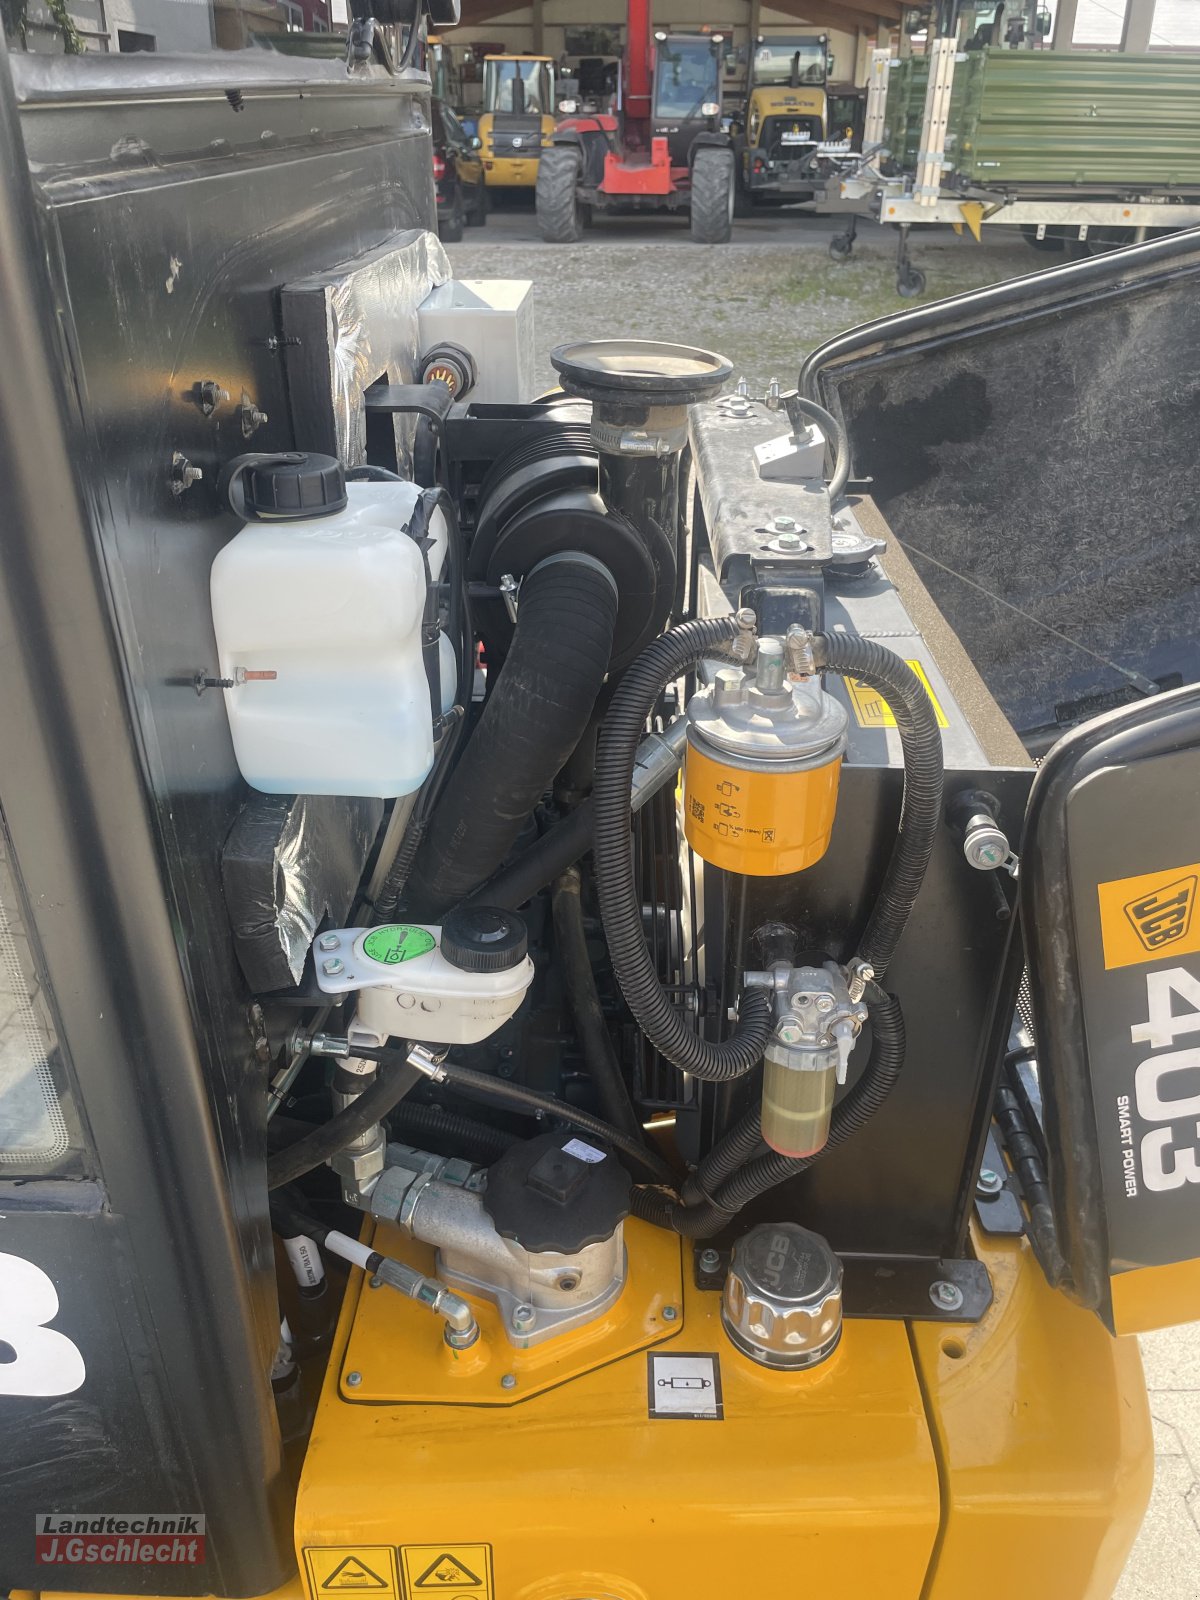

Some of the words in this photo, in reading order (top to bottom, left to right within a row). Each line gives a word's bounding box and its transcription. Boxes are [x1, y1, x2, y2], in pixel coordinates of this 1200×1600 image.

[1132, 888, 1189, 946] JCB
[1131, 967, 1200, 1191] 403
[1117, 1095, 1133, 1145] SMART
[1122, 1149, 1137, 1198] POWER
[764, 1235, 790, 1287] JCB
